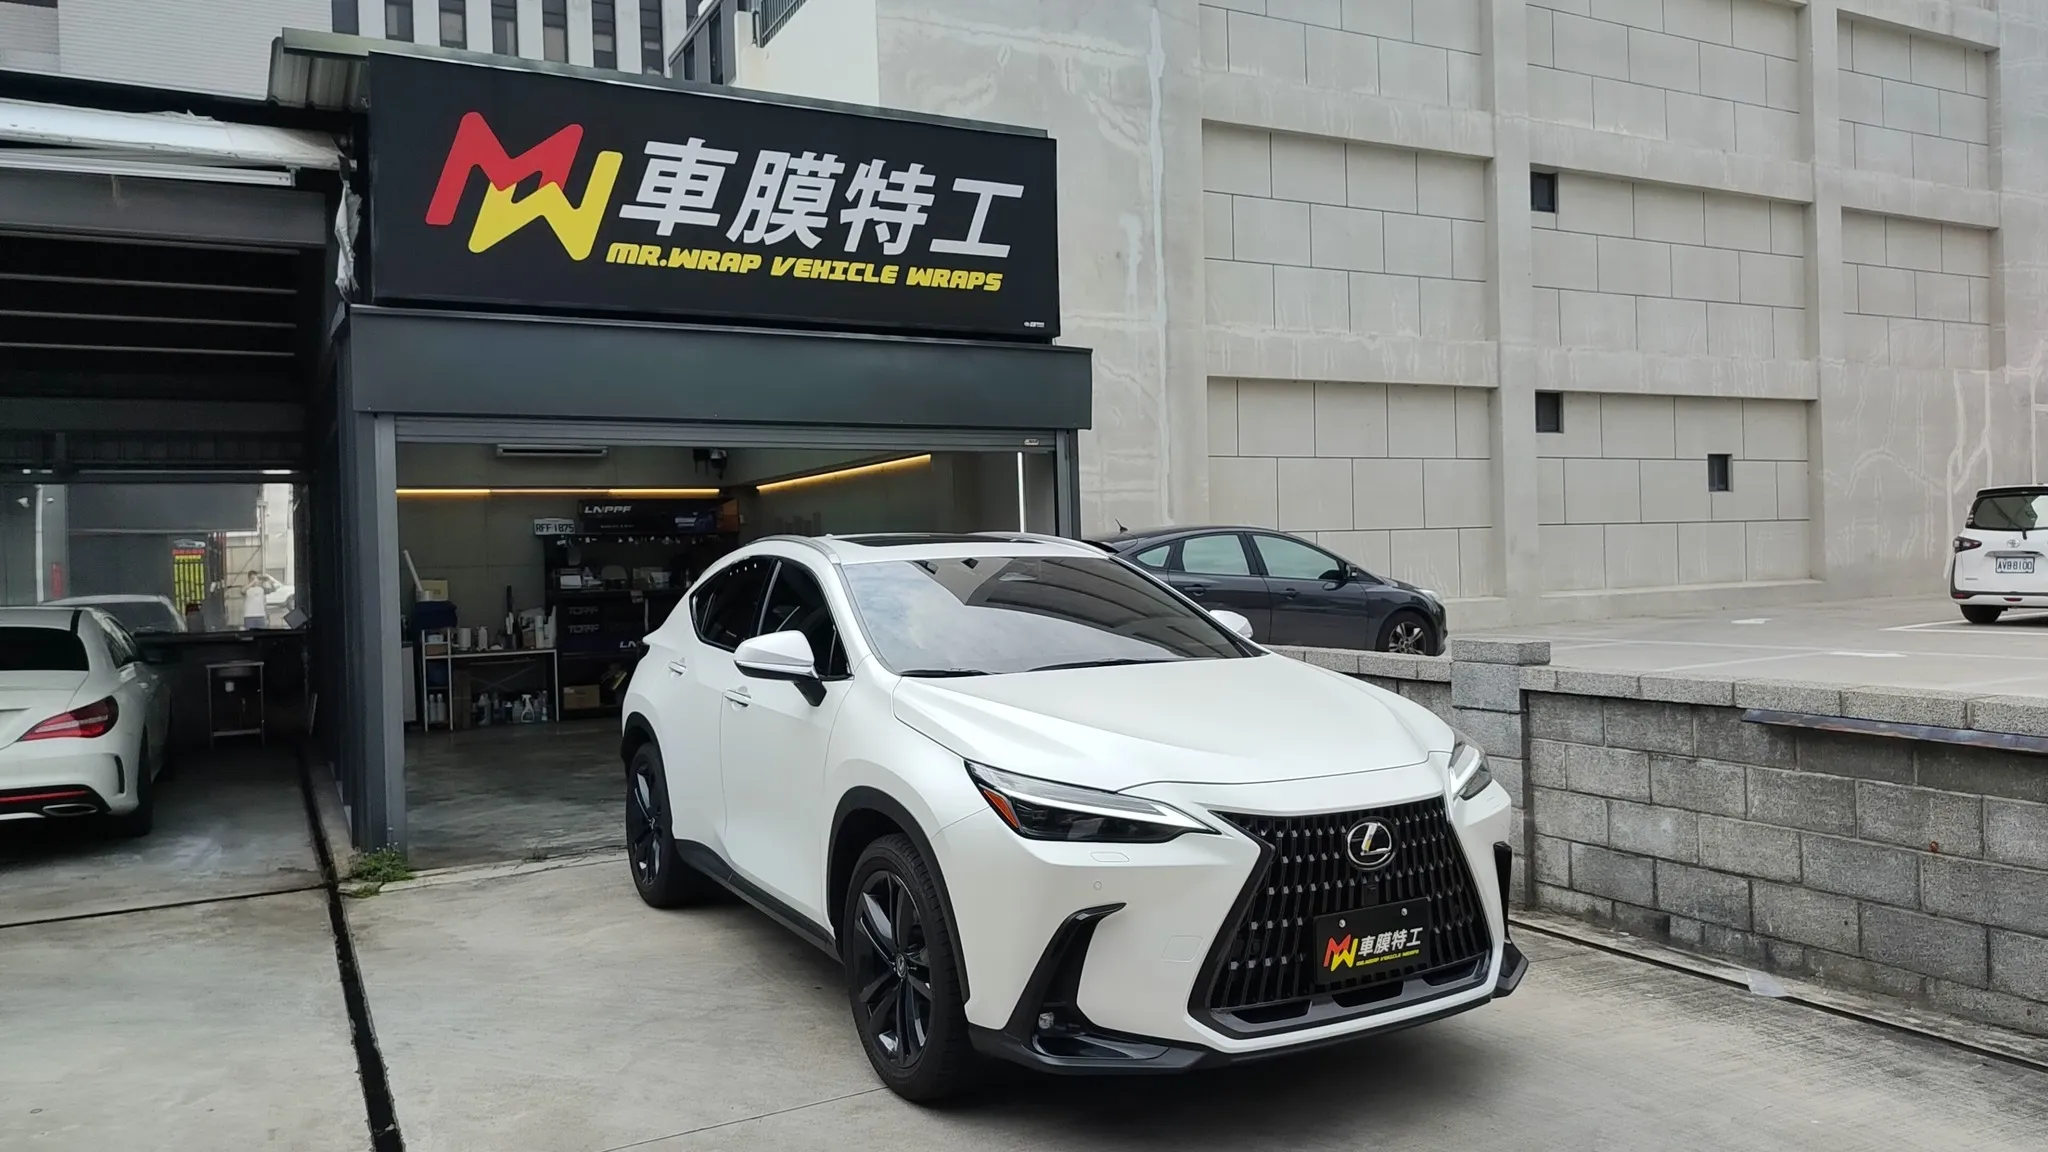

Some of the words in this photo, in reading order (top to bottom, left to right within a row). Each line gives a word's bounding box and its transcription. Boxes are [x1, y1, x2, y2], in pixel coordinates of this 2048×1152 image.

[618, 137, 1025, 259] 車膜特工
[605, 242, 762, 274] MR.WRAP
[770, 255, 900, 285] VEHICLE
[905, 266, 1003, 292] WRAPS
[1358, 927, 1424, 957] 車膜特工
